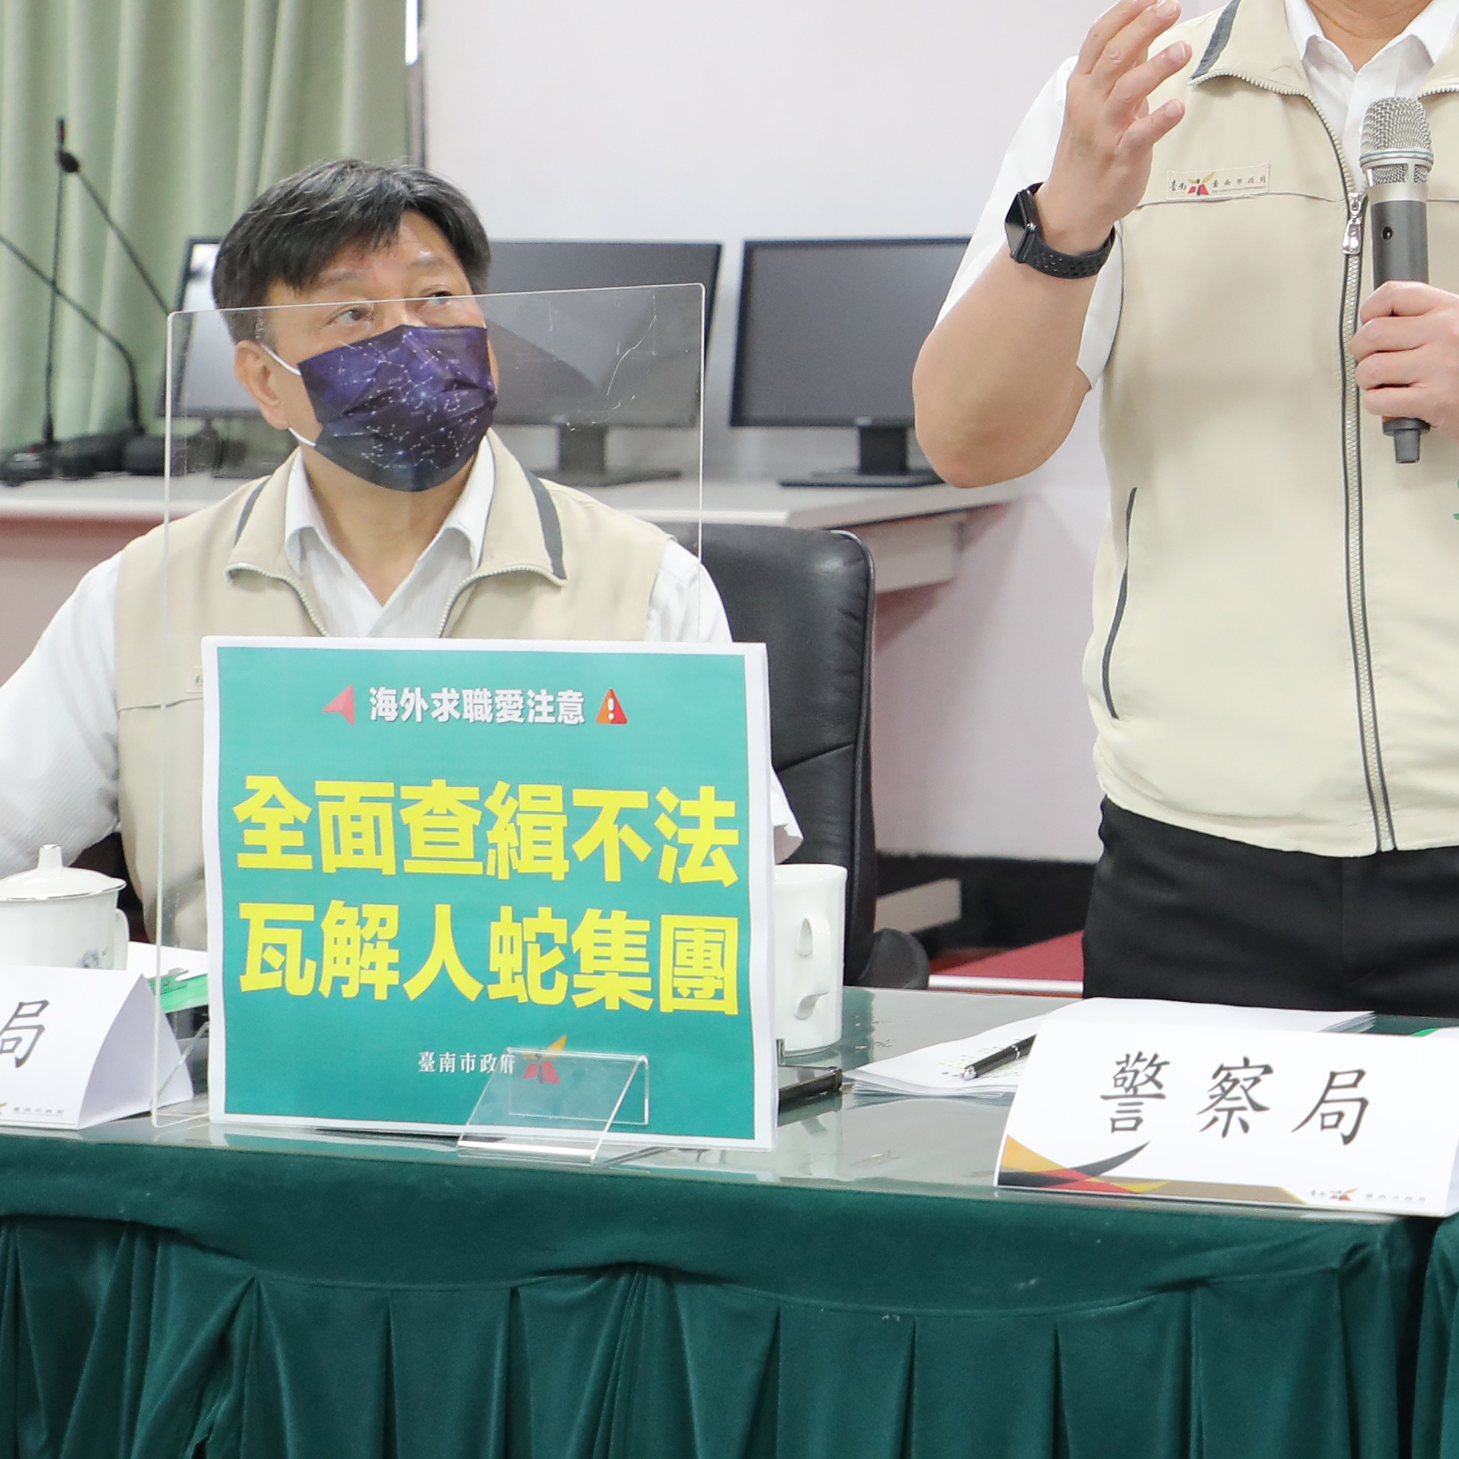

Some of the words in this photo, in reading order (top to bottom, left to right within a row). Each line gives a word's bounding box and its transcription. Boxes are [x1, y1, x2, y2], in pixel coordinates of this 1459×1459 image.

[369, 685, 586, 727] 海外求職愛注意
[233, 775, 740, 888] 全面查緝不法
[238, 899, 741, 1017] 瓦解人蛇集團
[0, 999, 49, 1069] 局
[418, 1050, 516, 1074] 臺南市政府
[1100, 1049, 1371, 1147] 警察局
